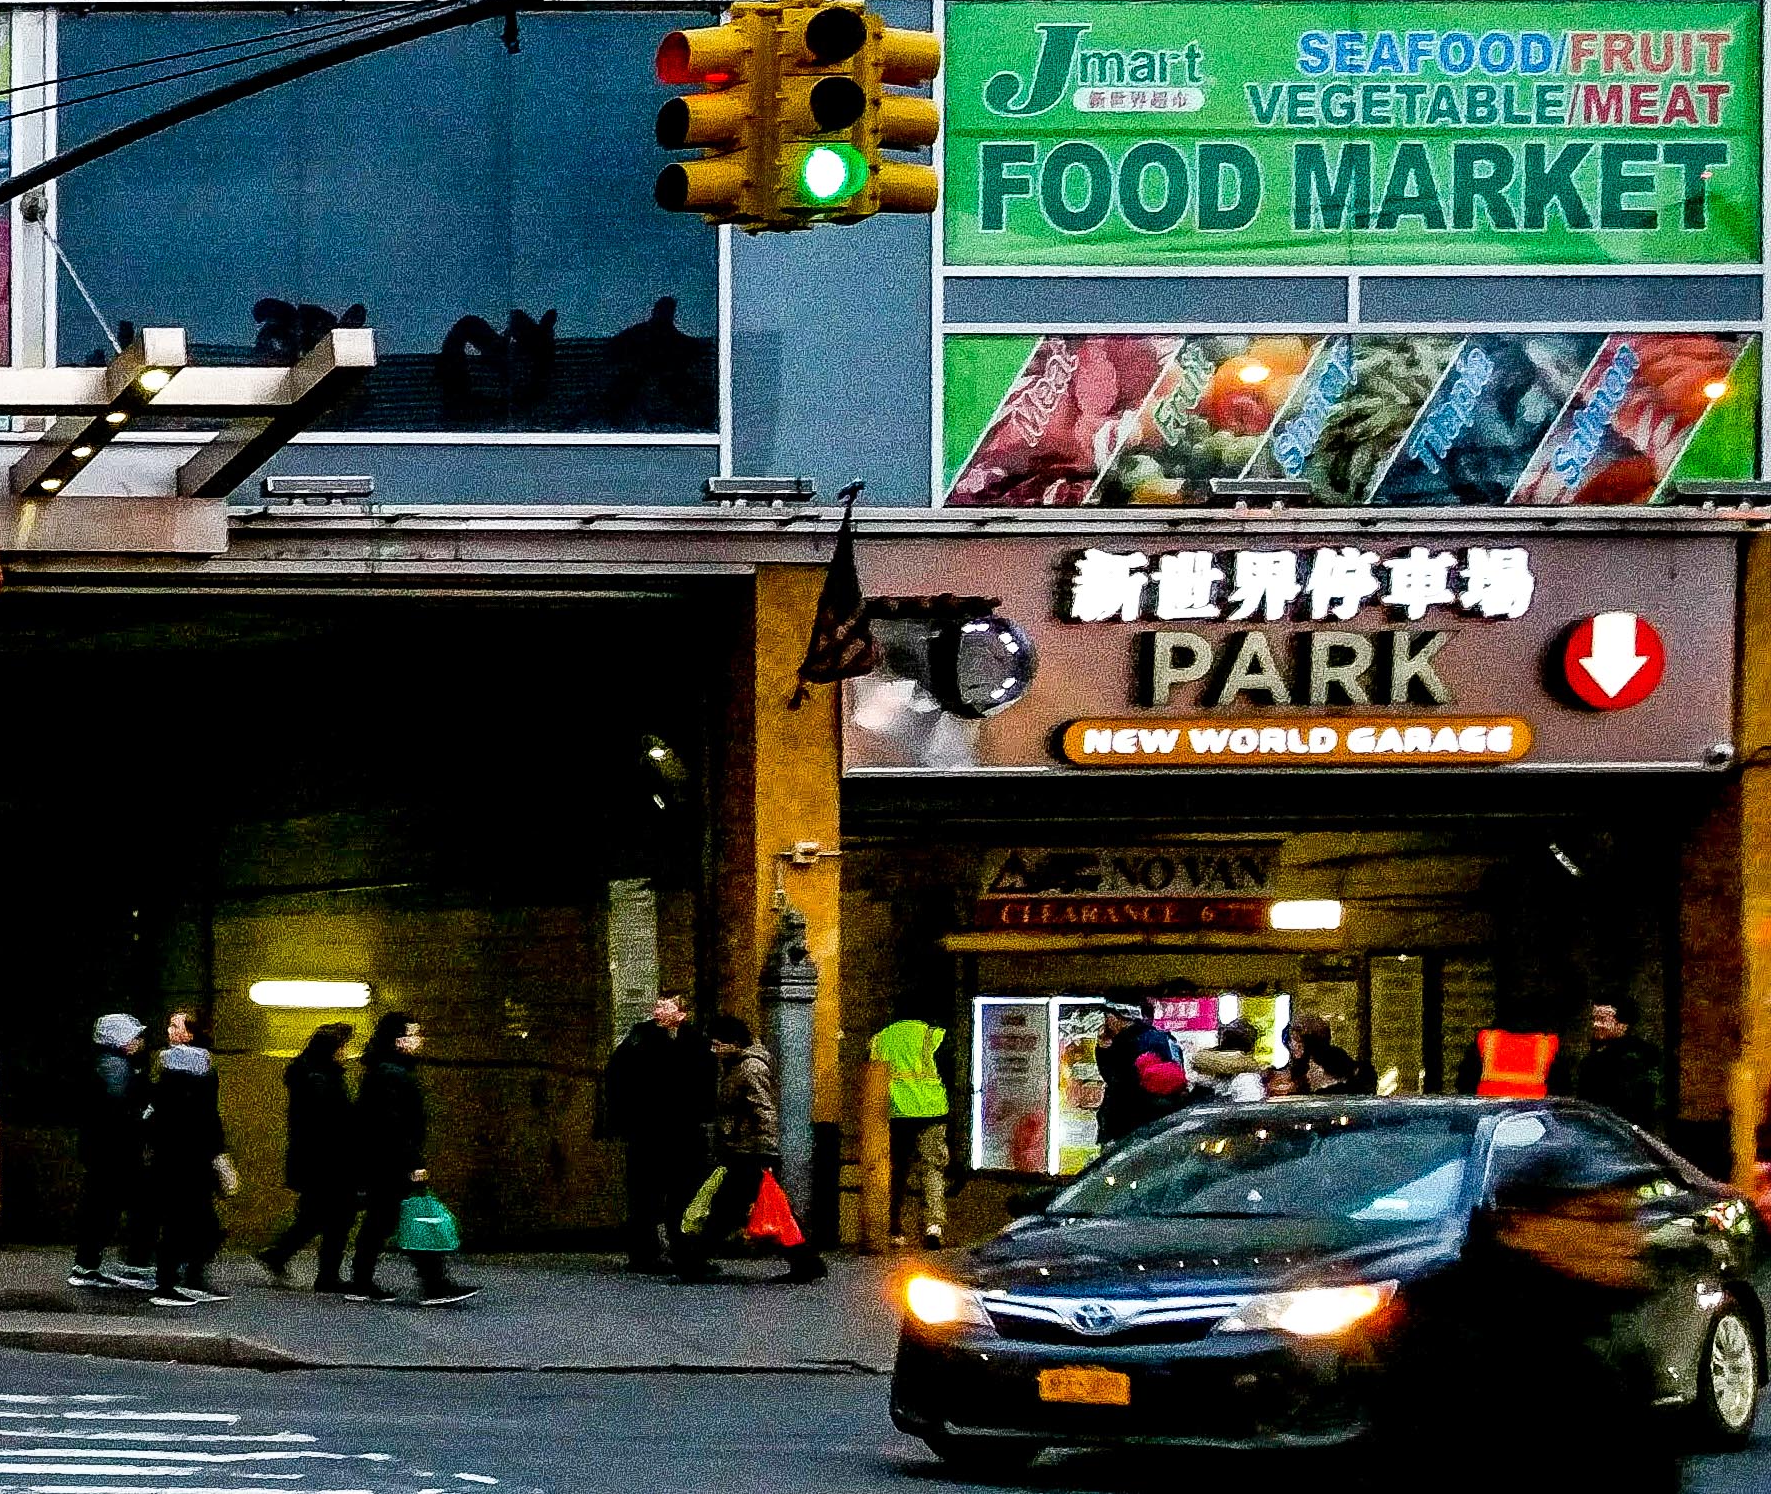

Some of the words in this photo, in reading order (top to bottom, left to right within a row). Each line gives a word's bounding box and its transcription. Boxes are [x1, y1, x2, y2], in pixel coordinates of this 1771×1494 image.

[1297, 29, 1731, 79] SEAFOOD/FRUIT
[1246, 80, 1731, 129] VEGETABLE/MEAT
[978, 140, 1260, 234] FOOD
[1292, 140, 1729, 234] MARKET
[1070, 546, 1536, 624] 新世界停車場
[1150, 630, 1459, 707] PARK
[1080, 725, 1182, 755] NEW
[1188, 725, 1337, 756] WORLD
[1346, 725, 1515, 755] GARAGE
